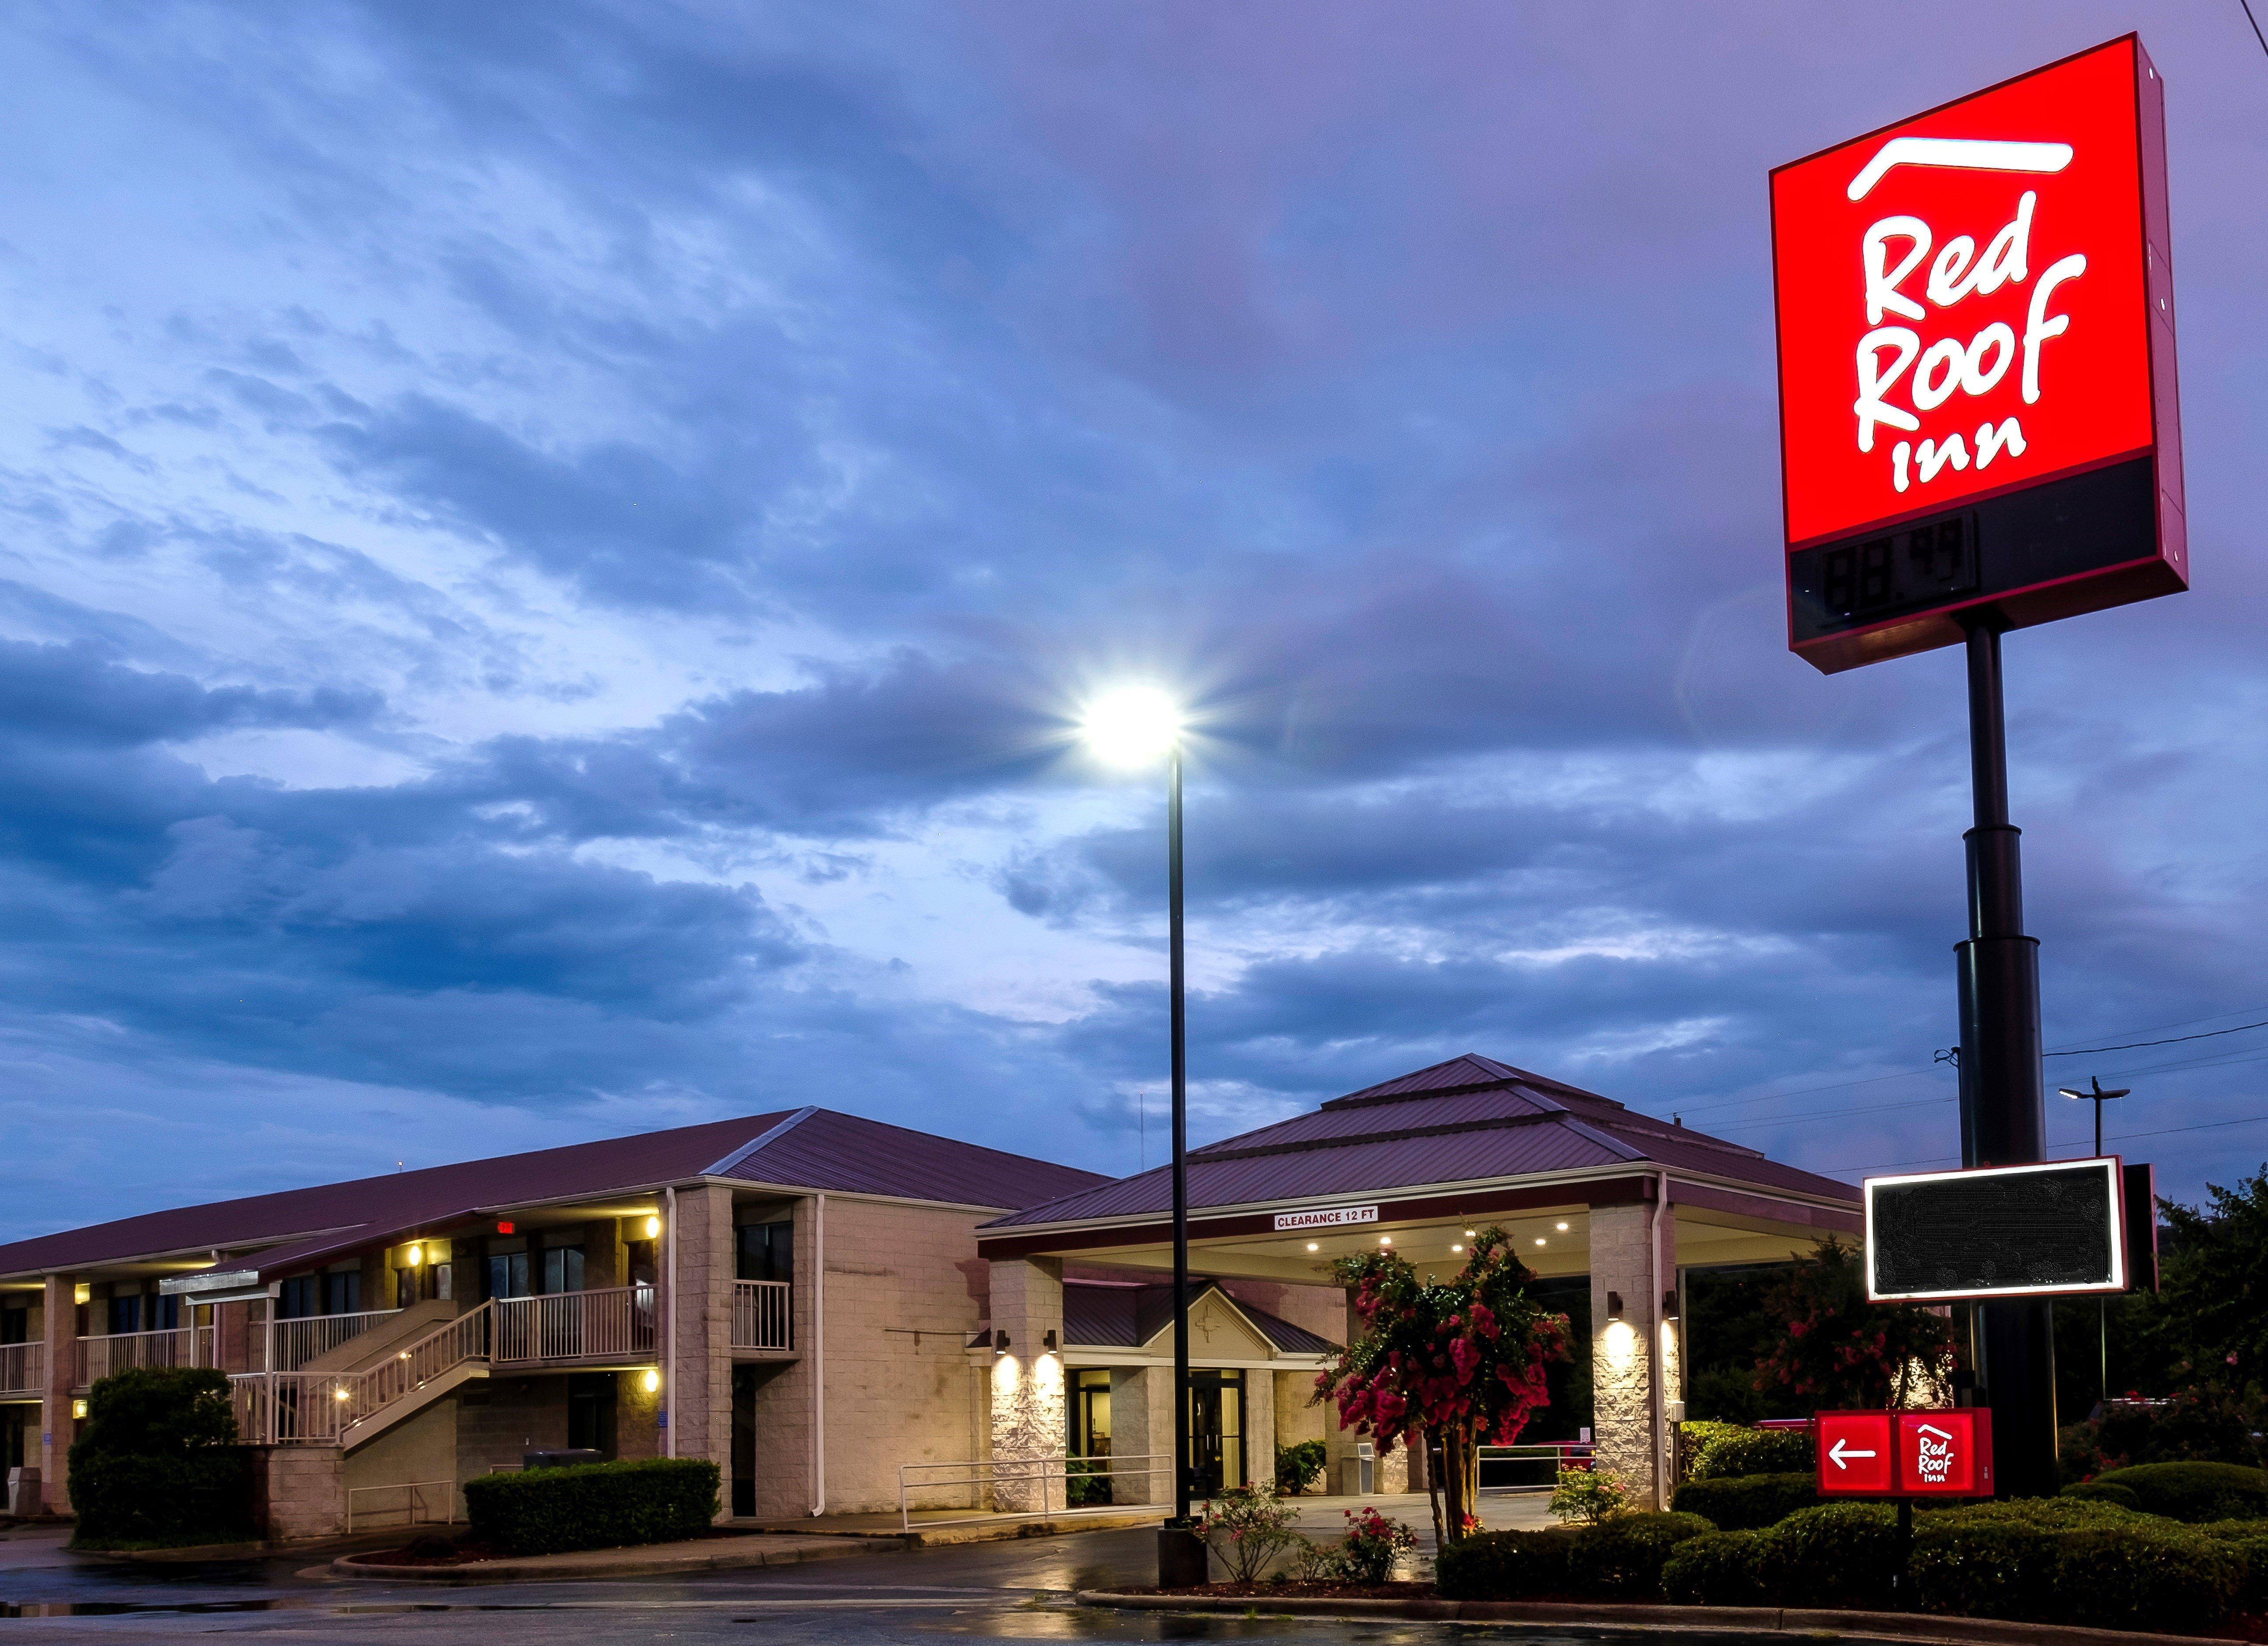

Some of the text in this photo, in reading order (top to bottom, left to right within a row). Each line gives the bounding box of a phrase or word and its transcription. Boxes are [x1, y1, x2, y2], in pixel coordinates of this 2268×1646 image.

[1862, 190, 2037, 328] Red
[1853, 253, 2087, 453] Roof
[1278, 1209, 1375, 1228] CLEARANCE 12 FT
[1920, 1437, 1948, 1456] Red
[1918, 1453, 1954, 1474] Roof
